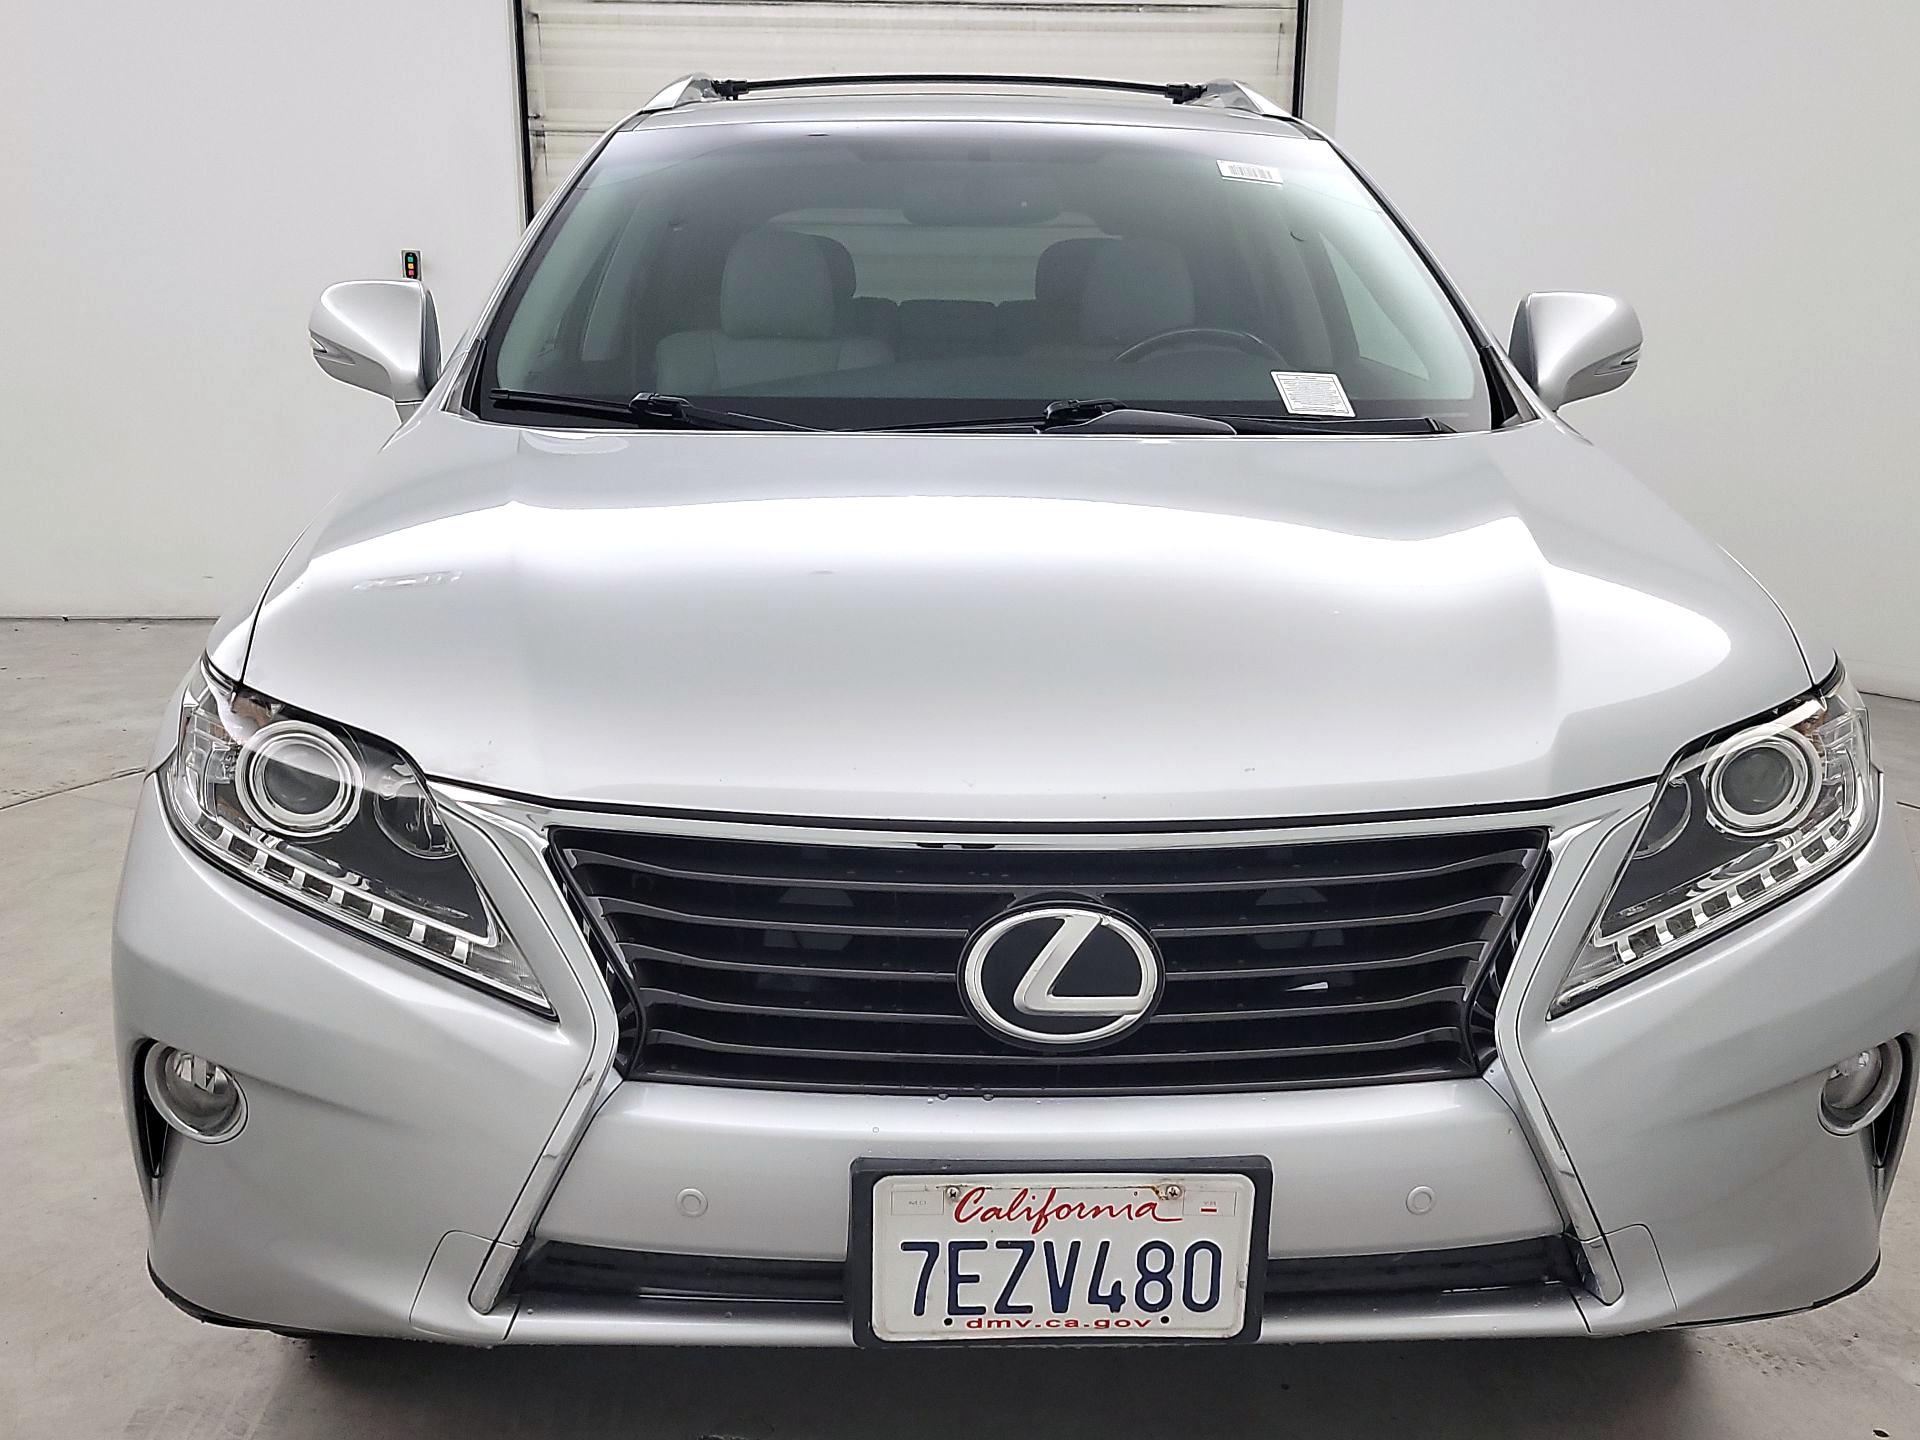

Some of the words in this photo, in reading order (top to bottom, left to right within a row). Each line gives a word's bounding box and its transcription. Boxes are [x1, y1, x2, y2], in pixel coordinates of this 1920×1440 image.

[953, 1187, 1183, 1234] California
[900, 1240, 1222, 1316] 7EZV480
[965, 1317, 1152, 1329] dmv.ca.gov
